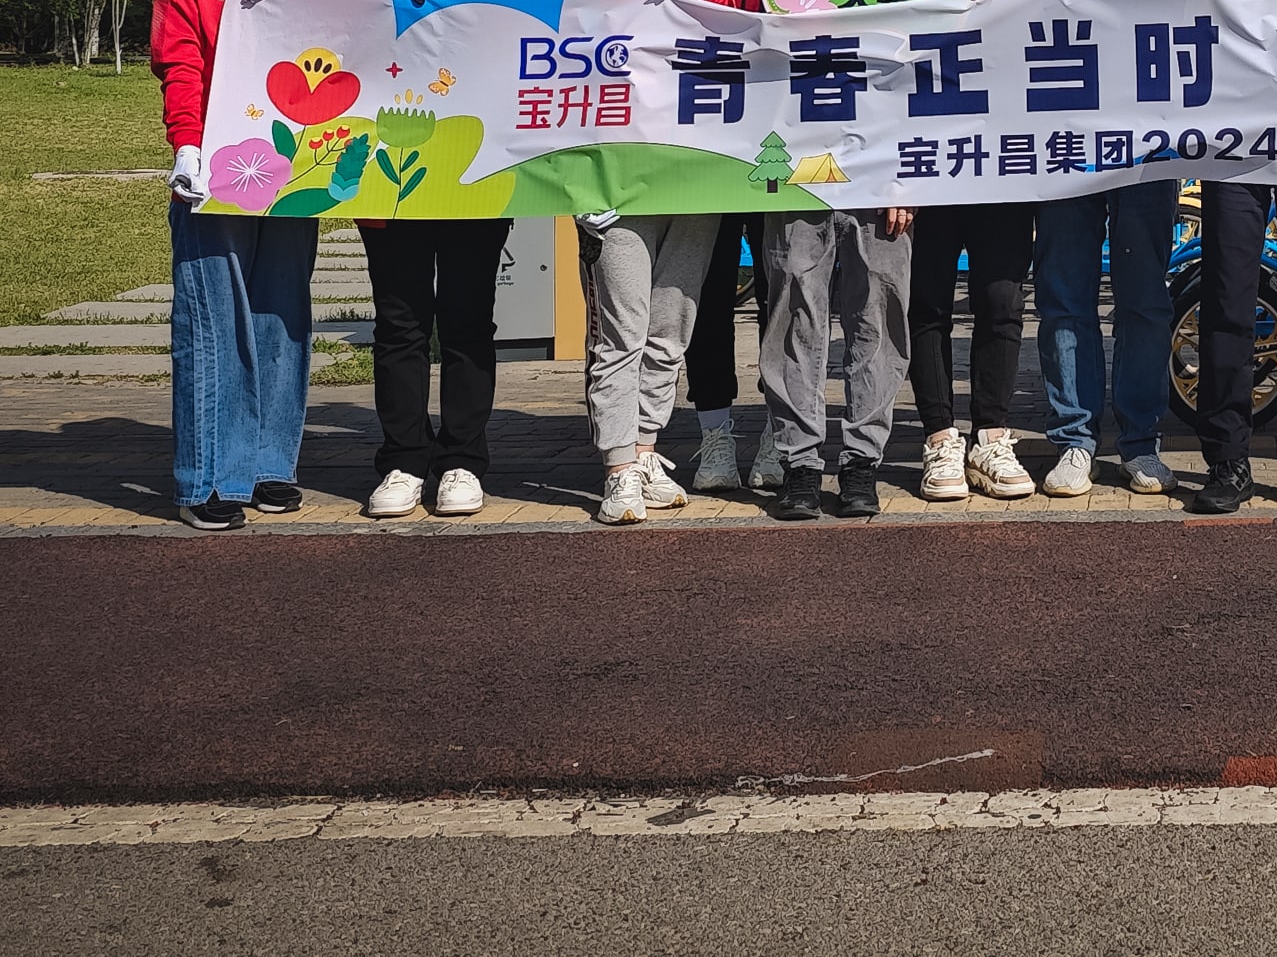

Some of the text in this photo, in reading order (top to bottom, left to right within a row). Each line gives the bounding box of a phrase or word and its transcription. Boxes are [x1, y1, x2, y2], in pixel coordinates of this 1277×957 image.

[519, 35, 635, 80] BSC
[515, 83, 632, 129] 宝升昌
